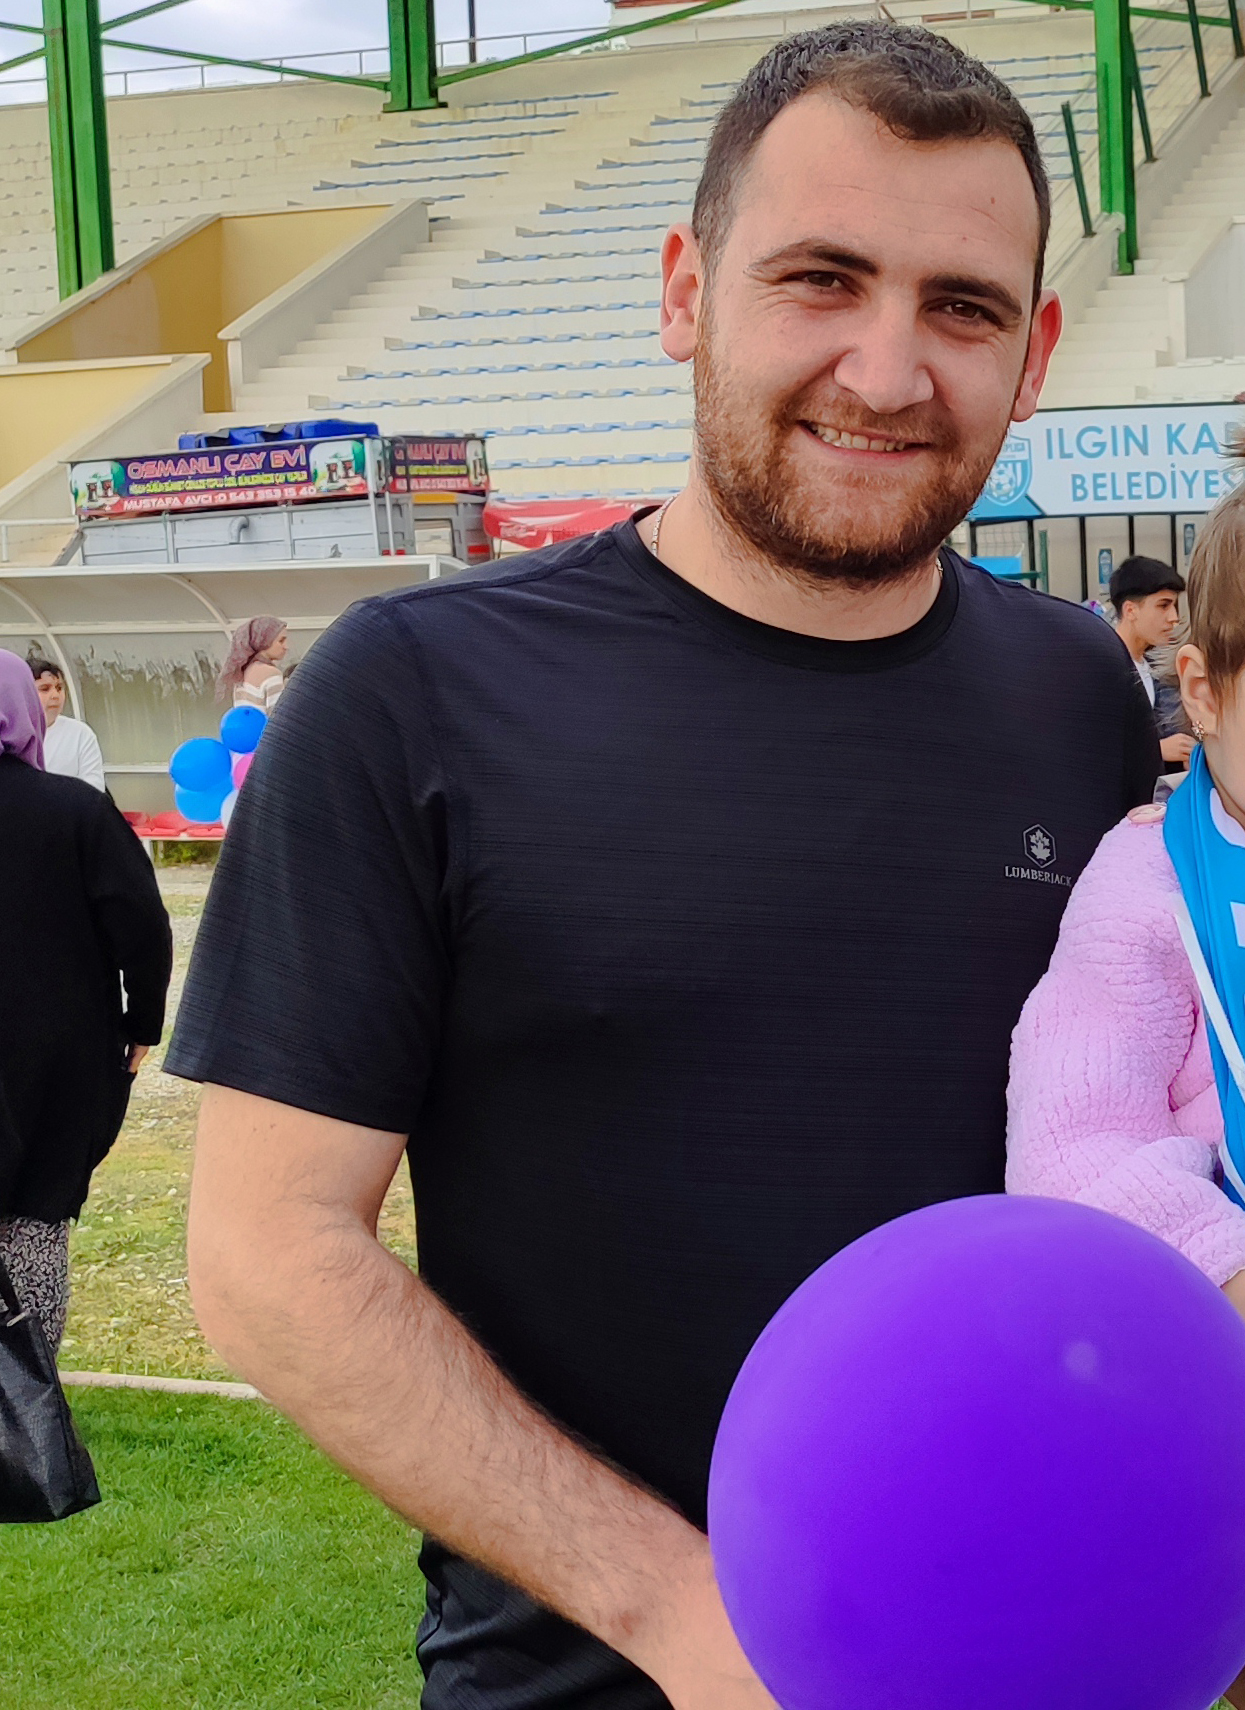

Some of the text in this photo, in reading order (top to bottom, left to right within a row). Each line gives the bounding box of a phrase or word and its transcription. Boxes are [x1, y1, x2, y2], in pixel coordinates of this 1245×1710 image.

[1045, 424, 1150, 460] ILGIN
[127, 444, 307, 480] OSMANLI ÇAY EVİ
[123, 496, 184, 511] MUSTAFA
[1004, 865, 1072, 887] LUMBERJACK
